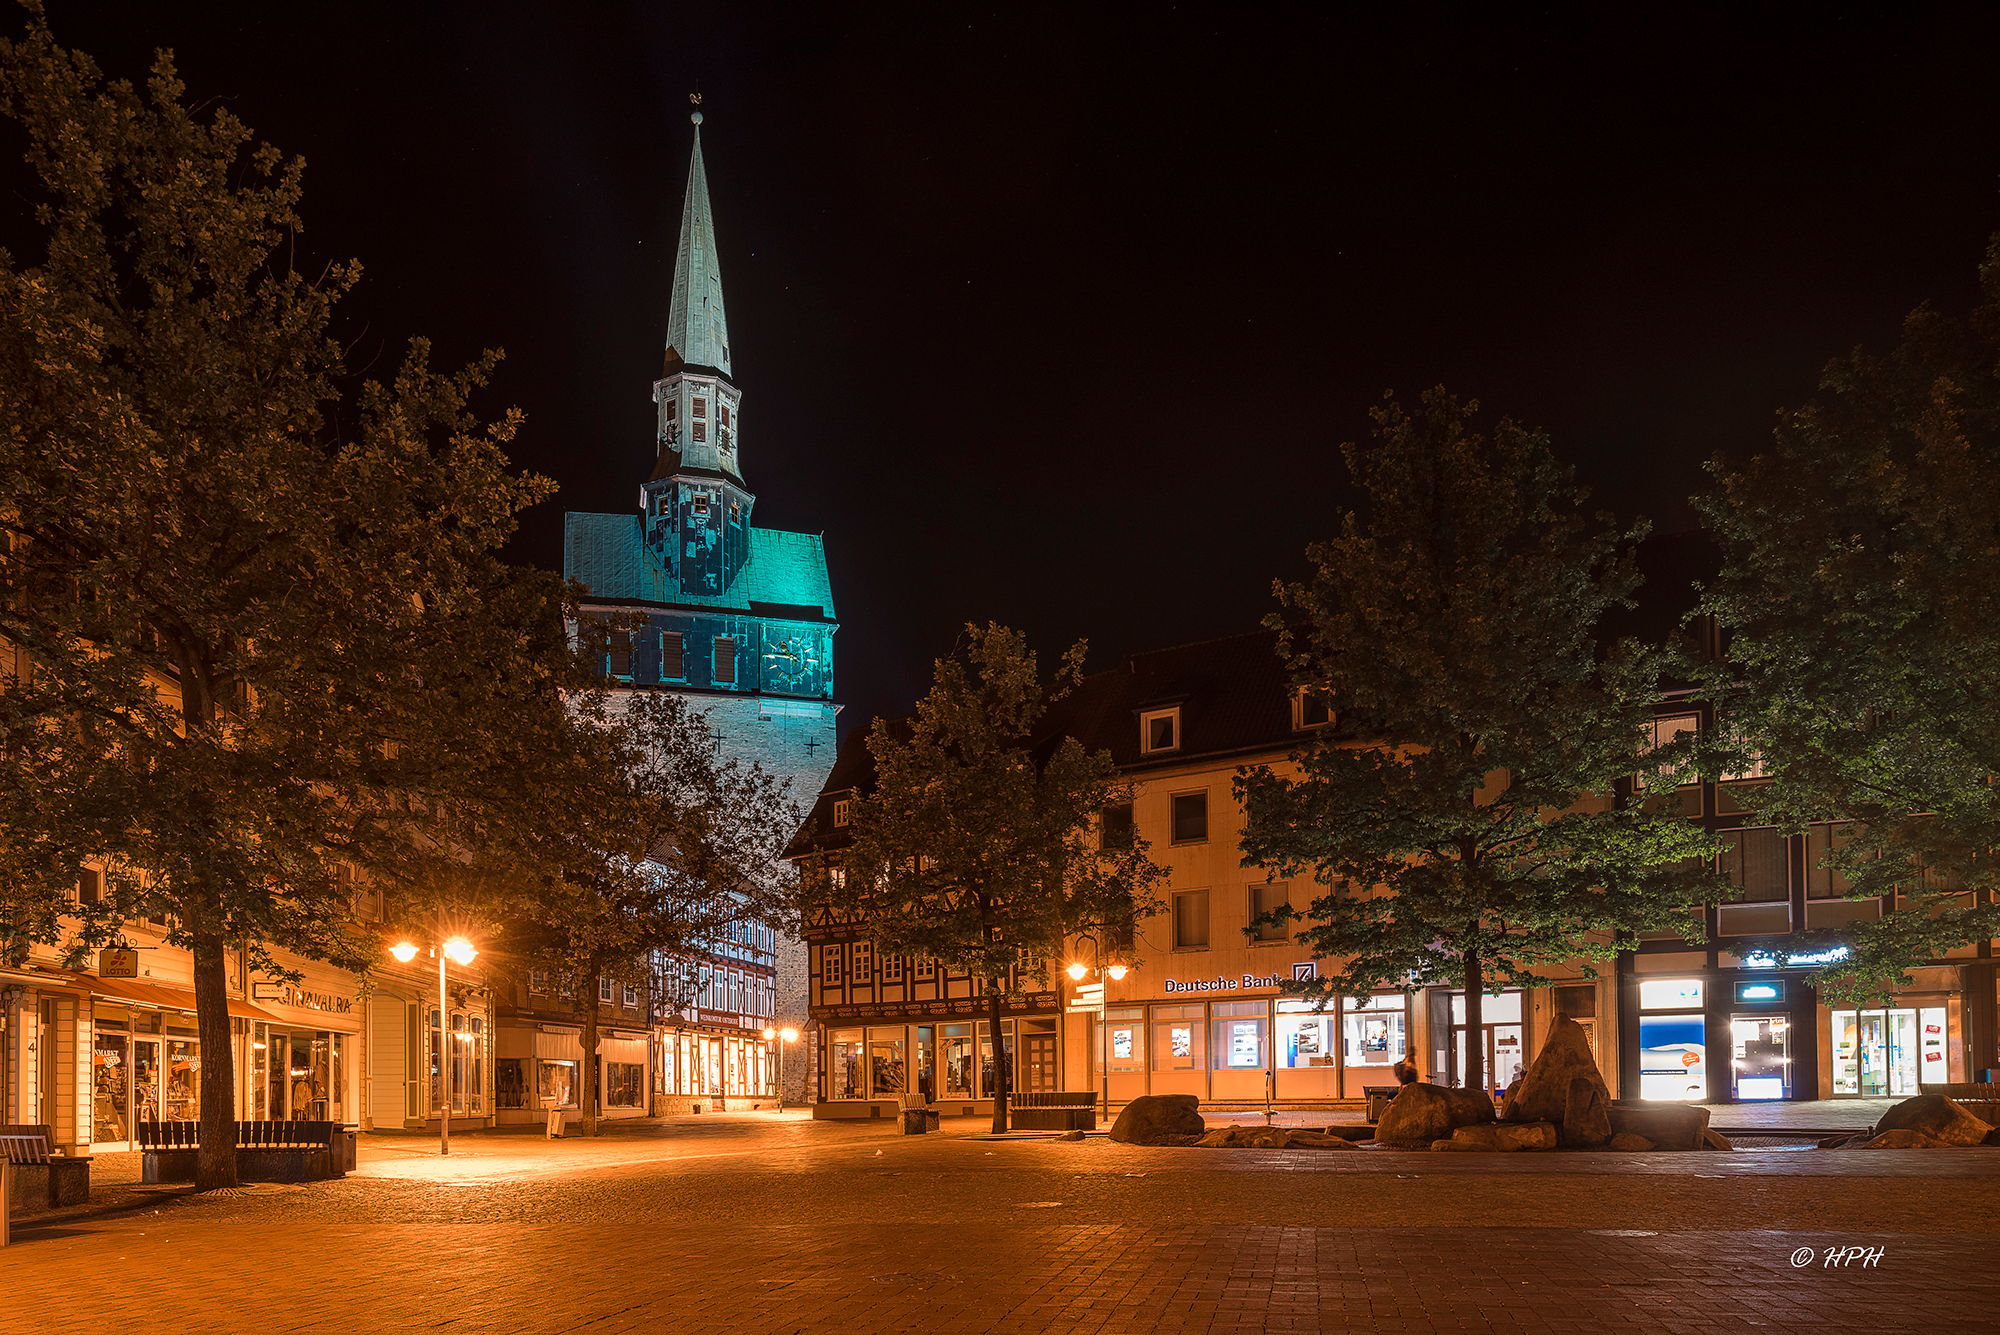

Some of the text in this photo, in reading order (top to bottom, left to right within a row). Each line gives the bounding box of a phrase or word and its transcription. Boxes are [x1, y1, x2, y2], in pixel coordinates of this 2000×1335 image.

[105, 967, 131, 975] LOTTO
[1165, 976, 1237, 993] Deutsche
[28, 1042, 35, 1053] 4
